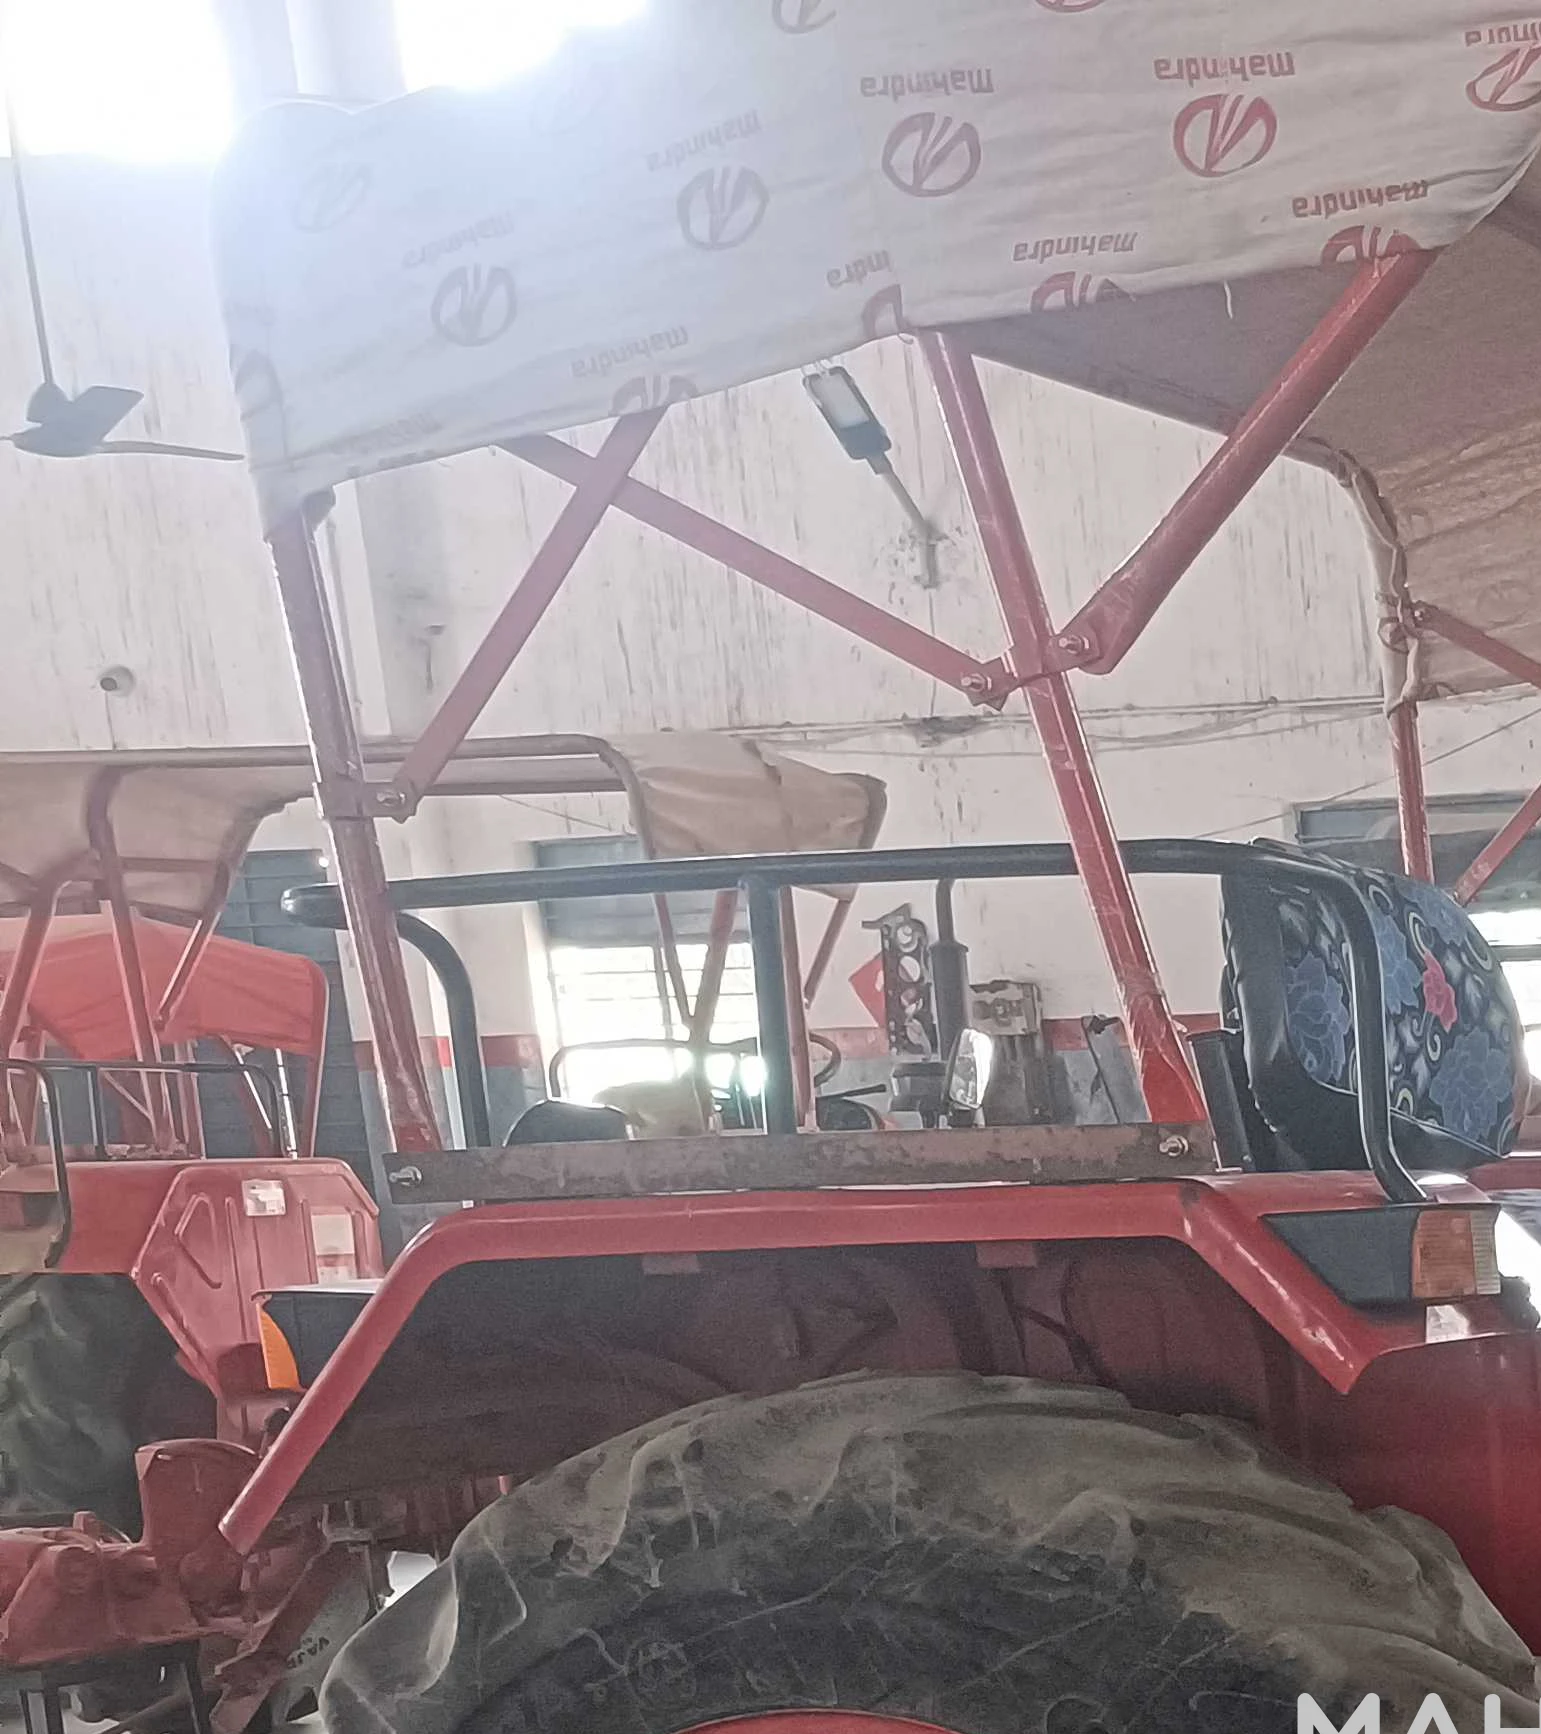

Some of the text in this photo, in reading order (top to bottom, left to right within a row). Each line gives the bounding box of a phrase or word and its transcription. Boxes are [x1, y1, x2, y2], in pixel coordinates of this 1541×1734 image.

[860, 66, 995, 101] Mahindra
[1152, 52, 1296, 85] Mahindra
[1012, 231, 1140, 263] Mahindra
